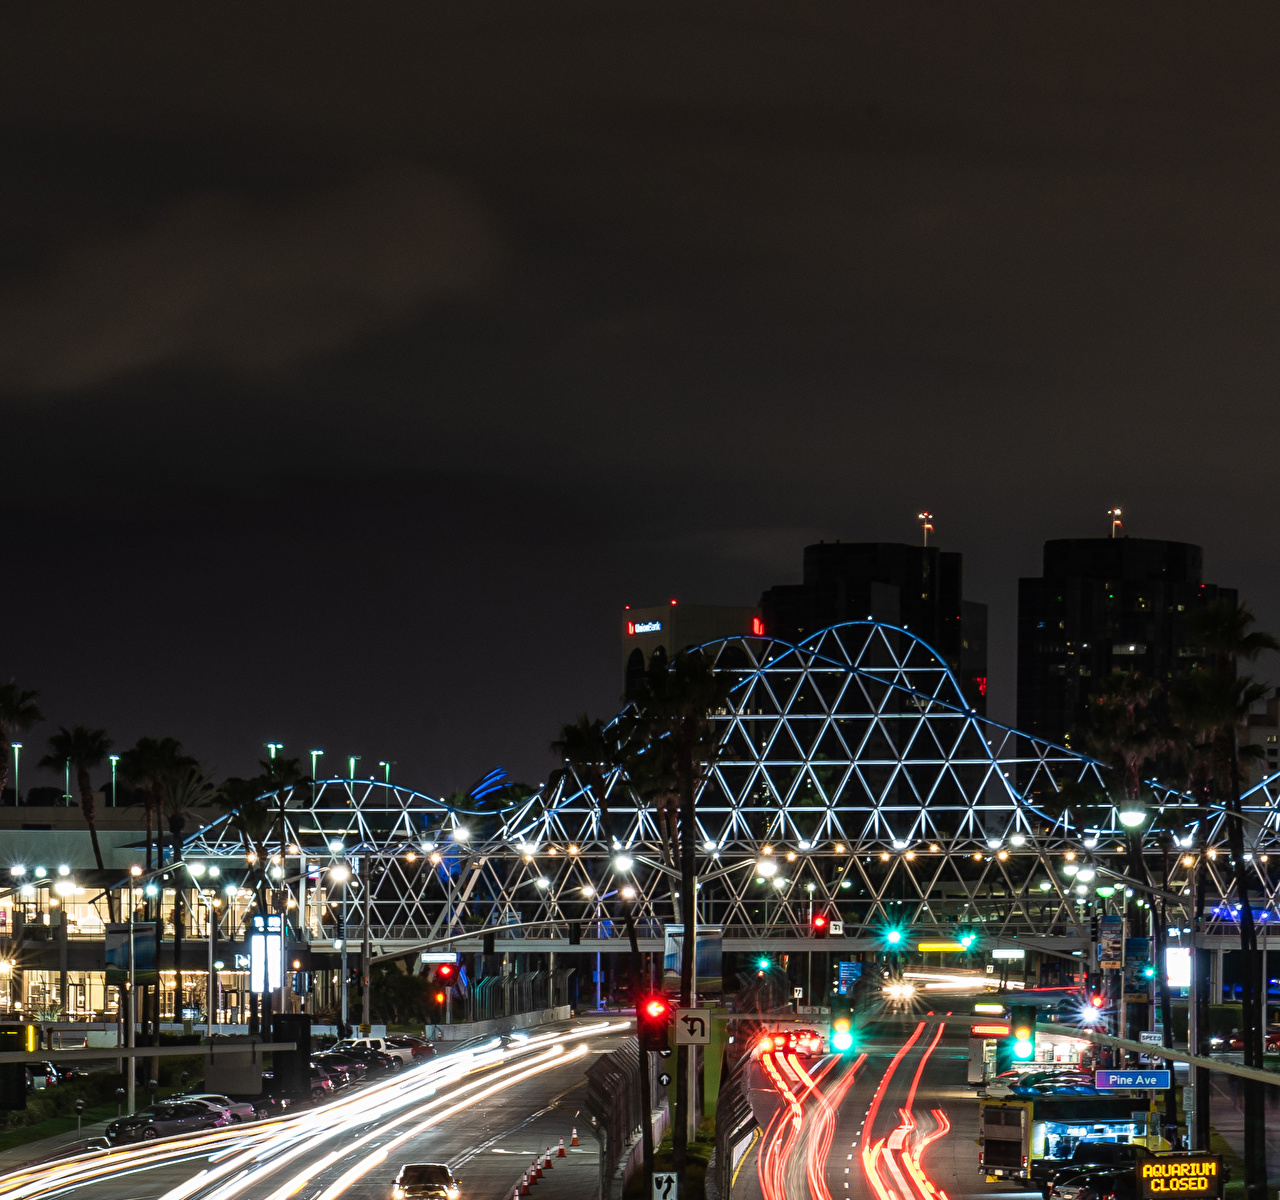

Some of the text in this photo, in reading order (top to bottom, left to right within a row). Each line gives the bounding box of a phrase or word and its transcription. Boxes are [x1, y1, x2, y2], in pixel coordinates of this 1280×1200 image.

[1109, 1075, 1157, 1085] Pine Ave
[1142, 1162, 1217, 1178] AQUARIUM
[1150, 1176, 1209, 1192] CLOSED
